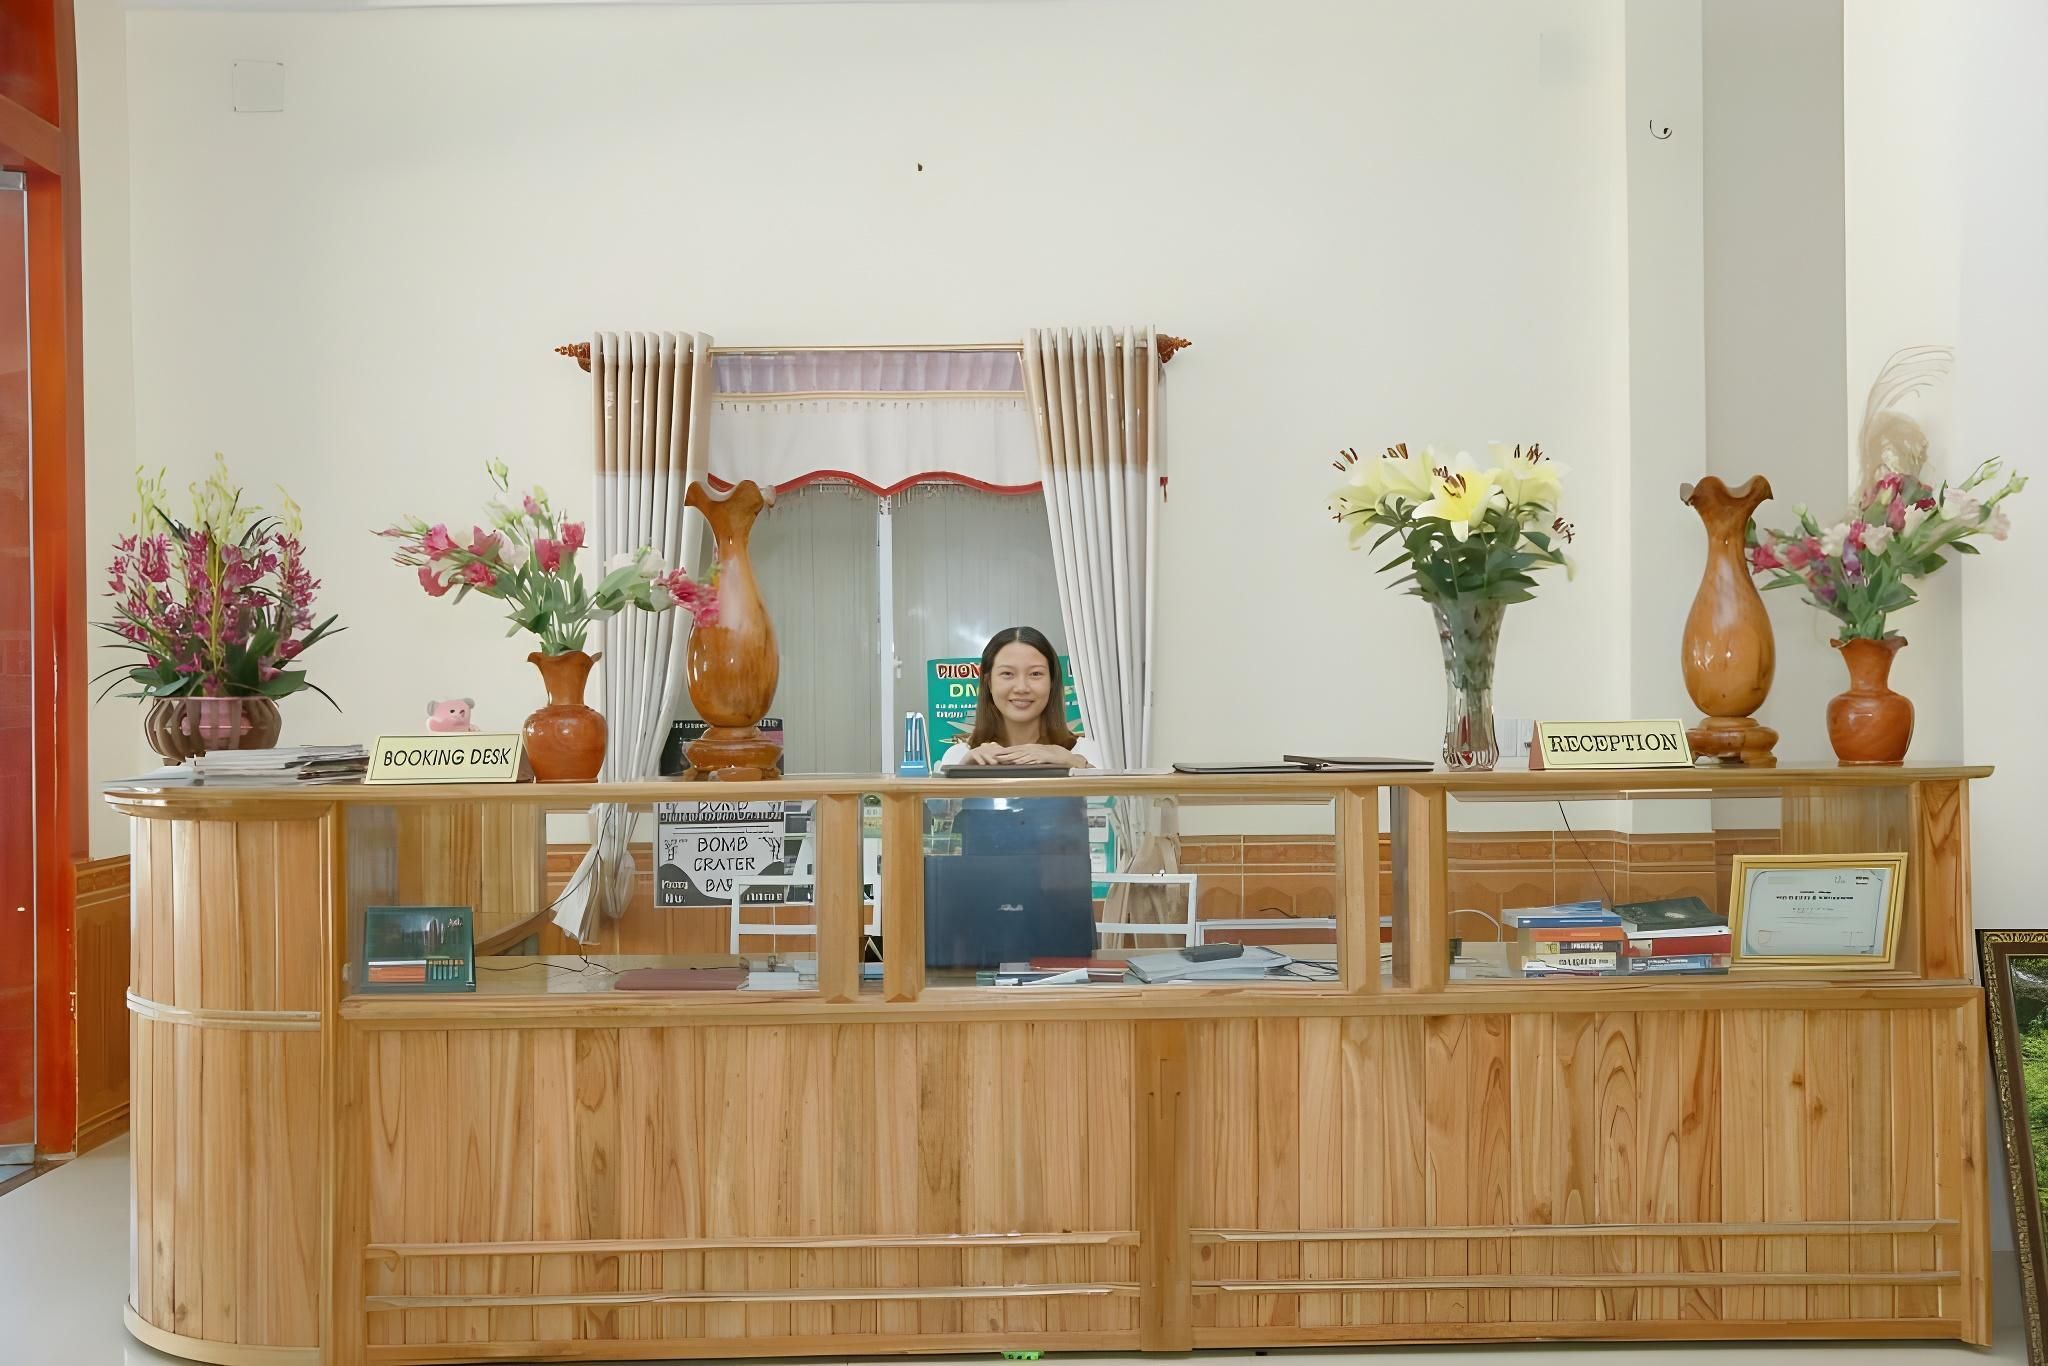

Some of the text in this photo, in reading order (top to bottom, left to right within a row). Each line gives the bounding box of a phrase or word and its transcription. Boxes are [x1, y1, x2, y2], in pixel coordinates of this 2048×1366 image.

[1547, 733, 1678, 753] RECEPTION
[383, 748, 512, 766] BOOKING DESK
[698, 836, 748, 852] BOMB
[694, 858, 756, 872] CRATER
